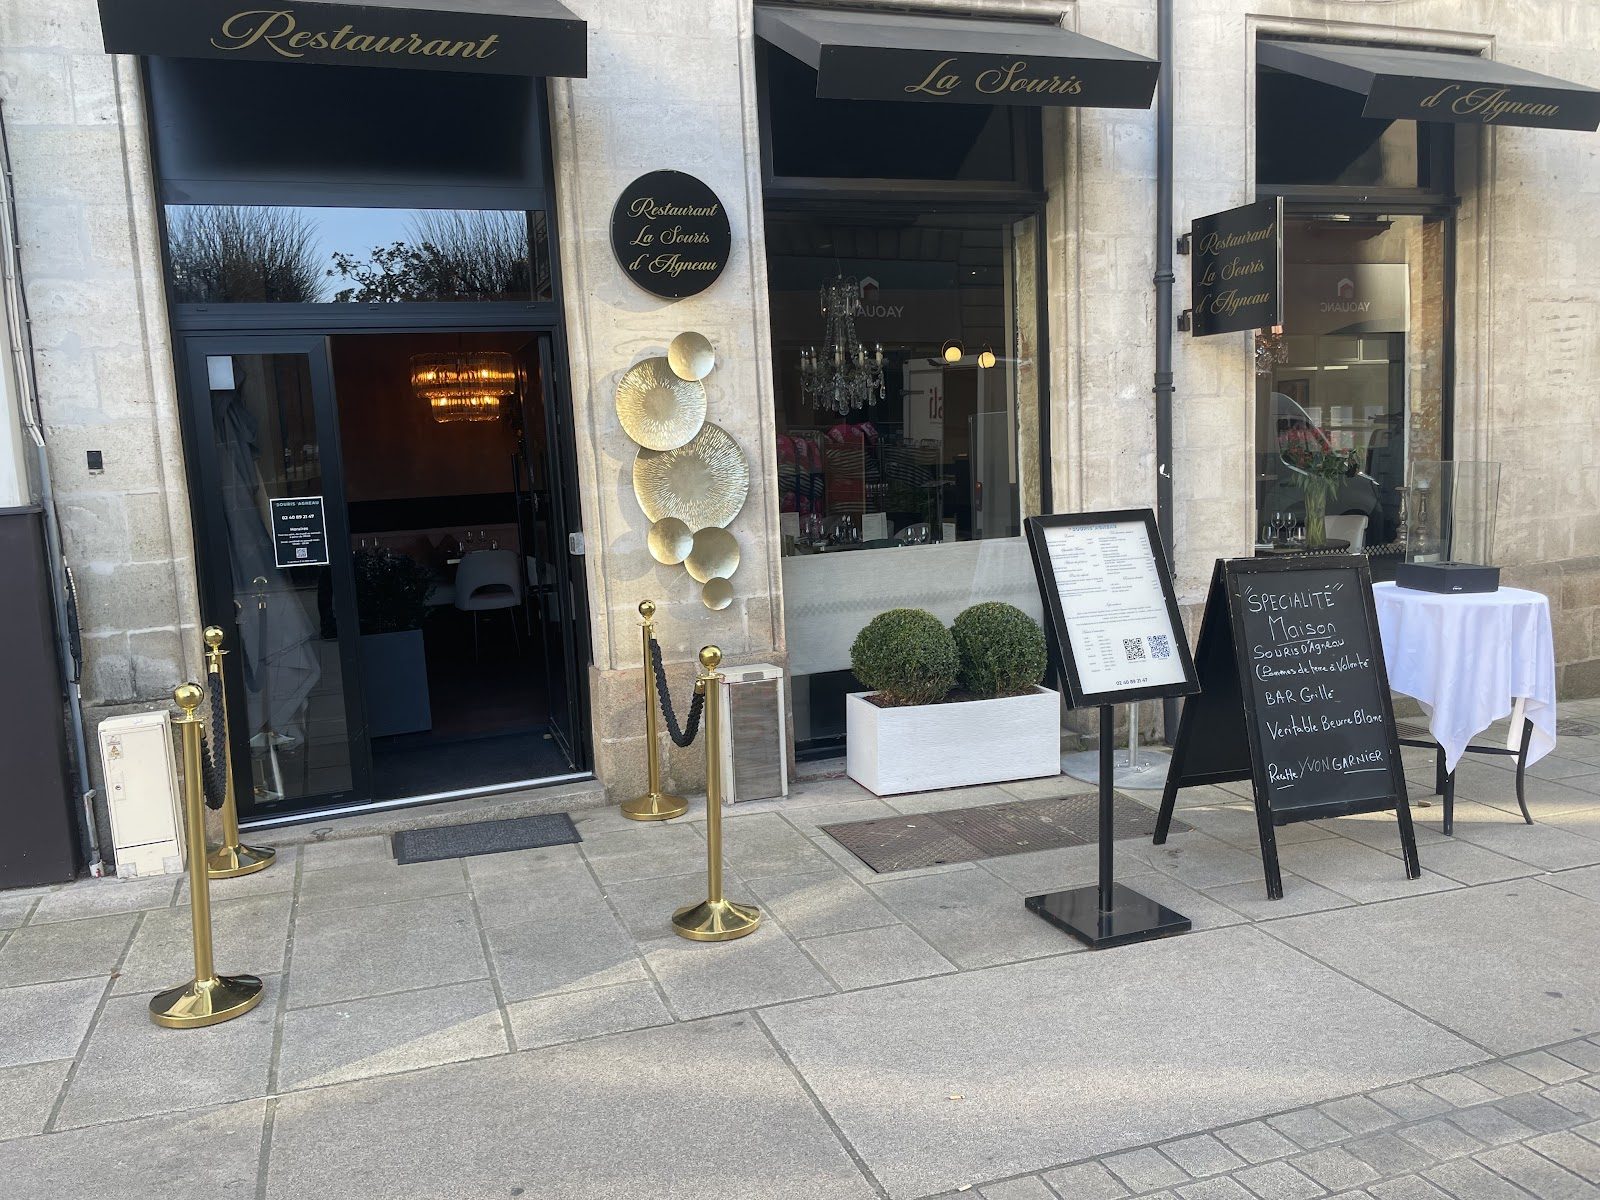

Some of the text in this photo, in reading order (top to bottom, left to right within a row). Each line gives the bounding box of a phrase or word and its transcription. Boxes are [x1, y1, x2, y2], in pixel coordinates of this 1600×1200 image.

[210, 10, 503, 59] Restaurant
[904, 57, 1084, 96] La Souris
[627, 197, 719, 220] Restaurant
[629, 225, 711, 247] La Souris
[1197, 223, 1275, 257] Restaurant
[1198, 257, 1265, 287] La Souris
[1268, 615, 1336, 641] Maison
[1265, 683, 1334, 706] BAR Grillé
[1266, 714, 1319, 740] Veritable
[1353, 708, 1382, 725] Blanc
[1298, 756, 1330, 779] YVON
